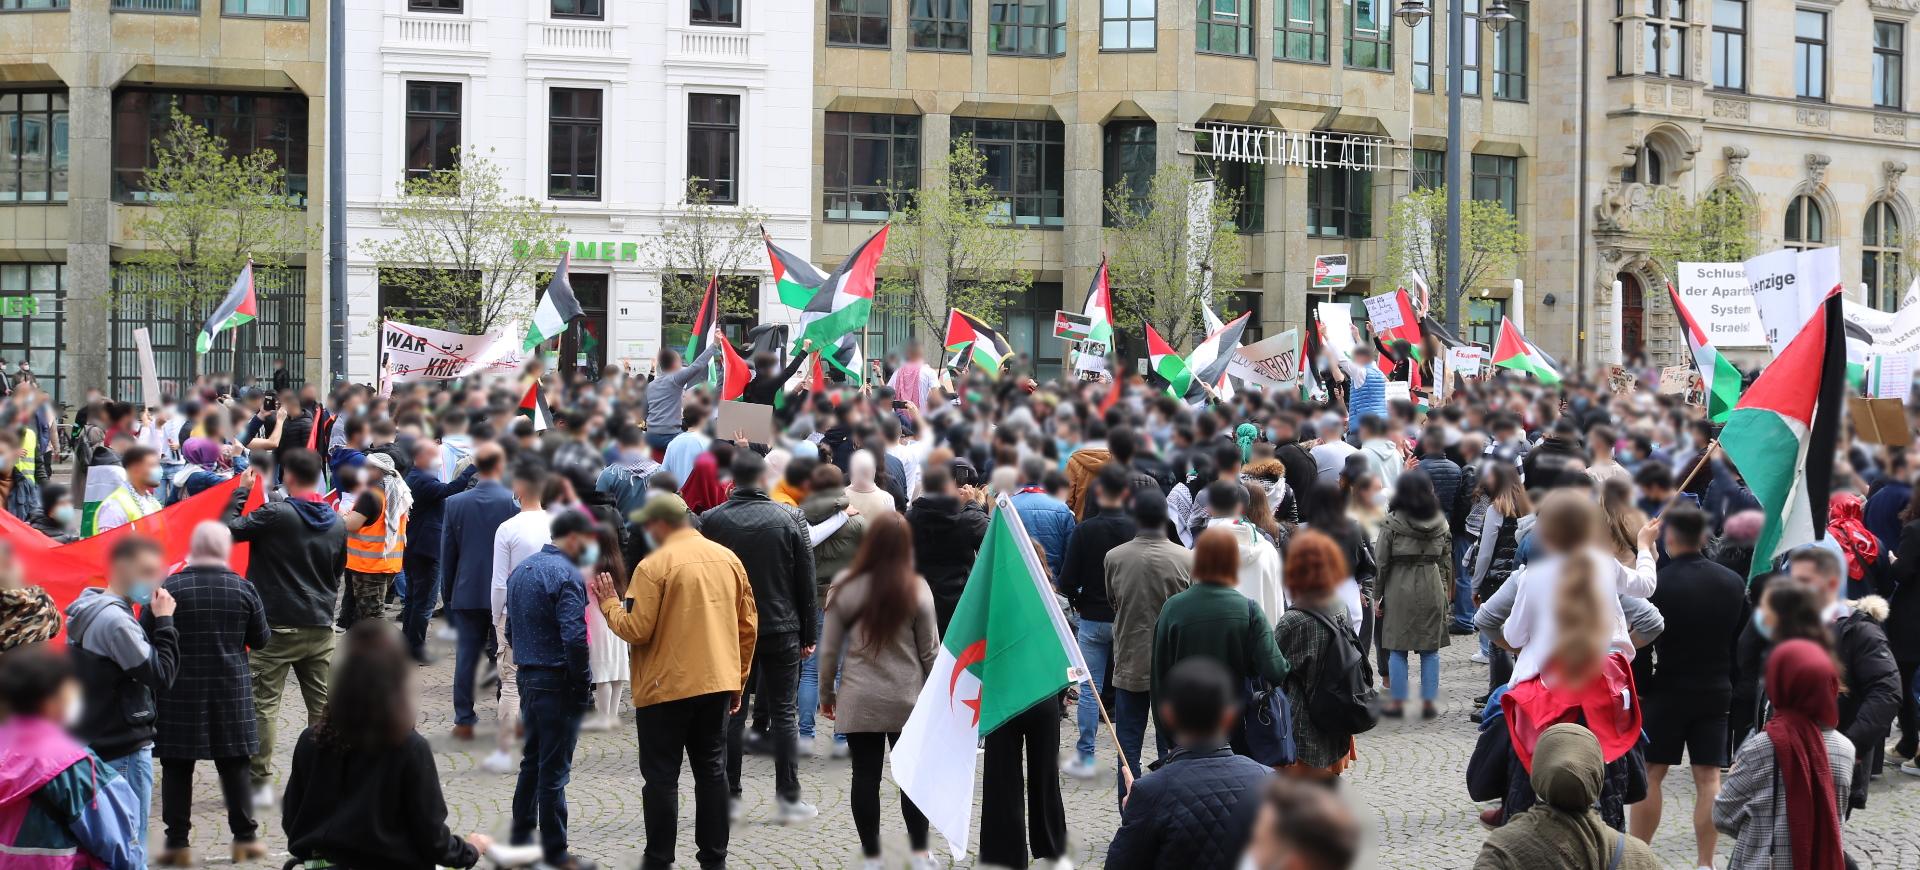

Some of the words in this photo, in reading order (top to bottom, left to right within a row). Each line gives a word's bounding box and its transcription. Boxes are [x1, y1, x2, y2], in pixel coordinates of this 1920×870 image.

[1213, 126, 1328, 169] MARKTHALLE
[1339, 136, 1382, 172] ACHT
[1685, 286, 1708, 296] der
[0, 296, 39, 317] ER
[620, 307, 628, 316] 11
[1711, 304, 1751, 317] System
[386, 330, 428, 353] WAR
[390, 361, 410, 377] avaş
